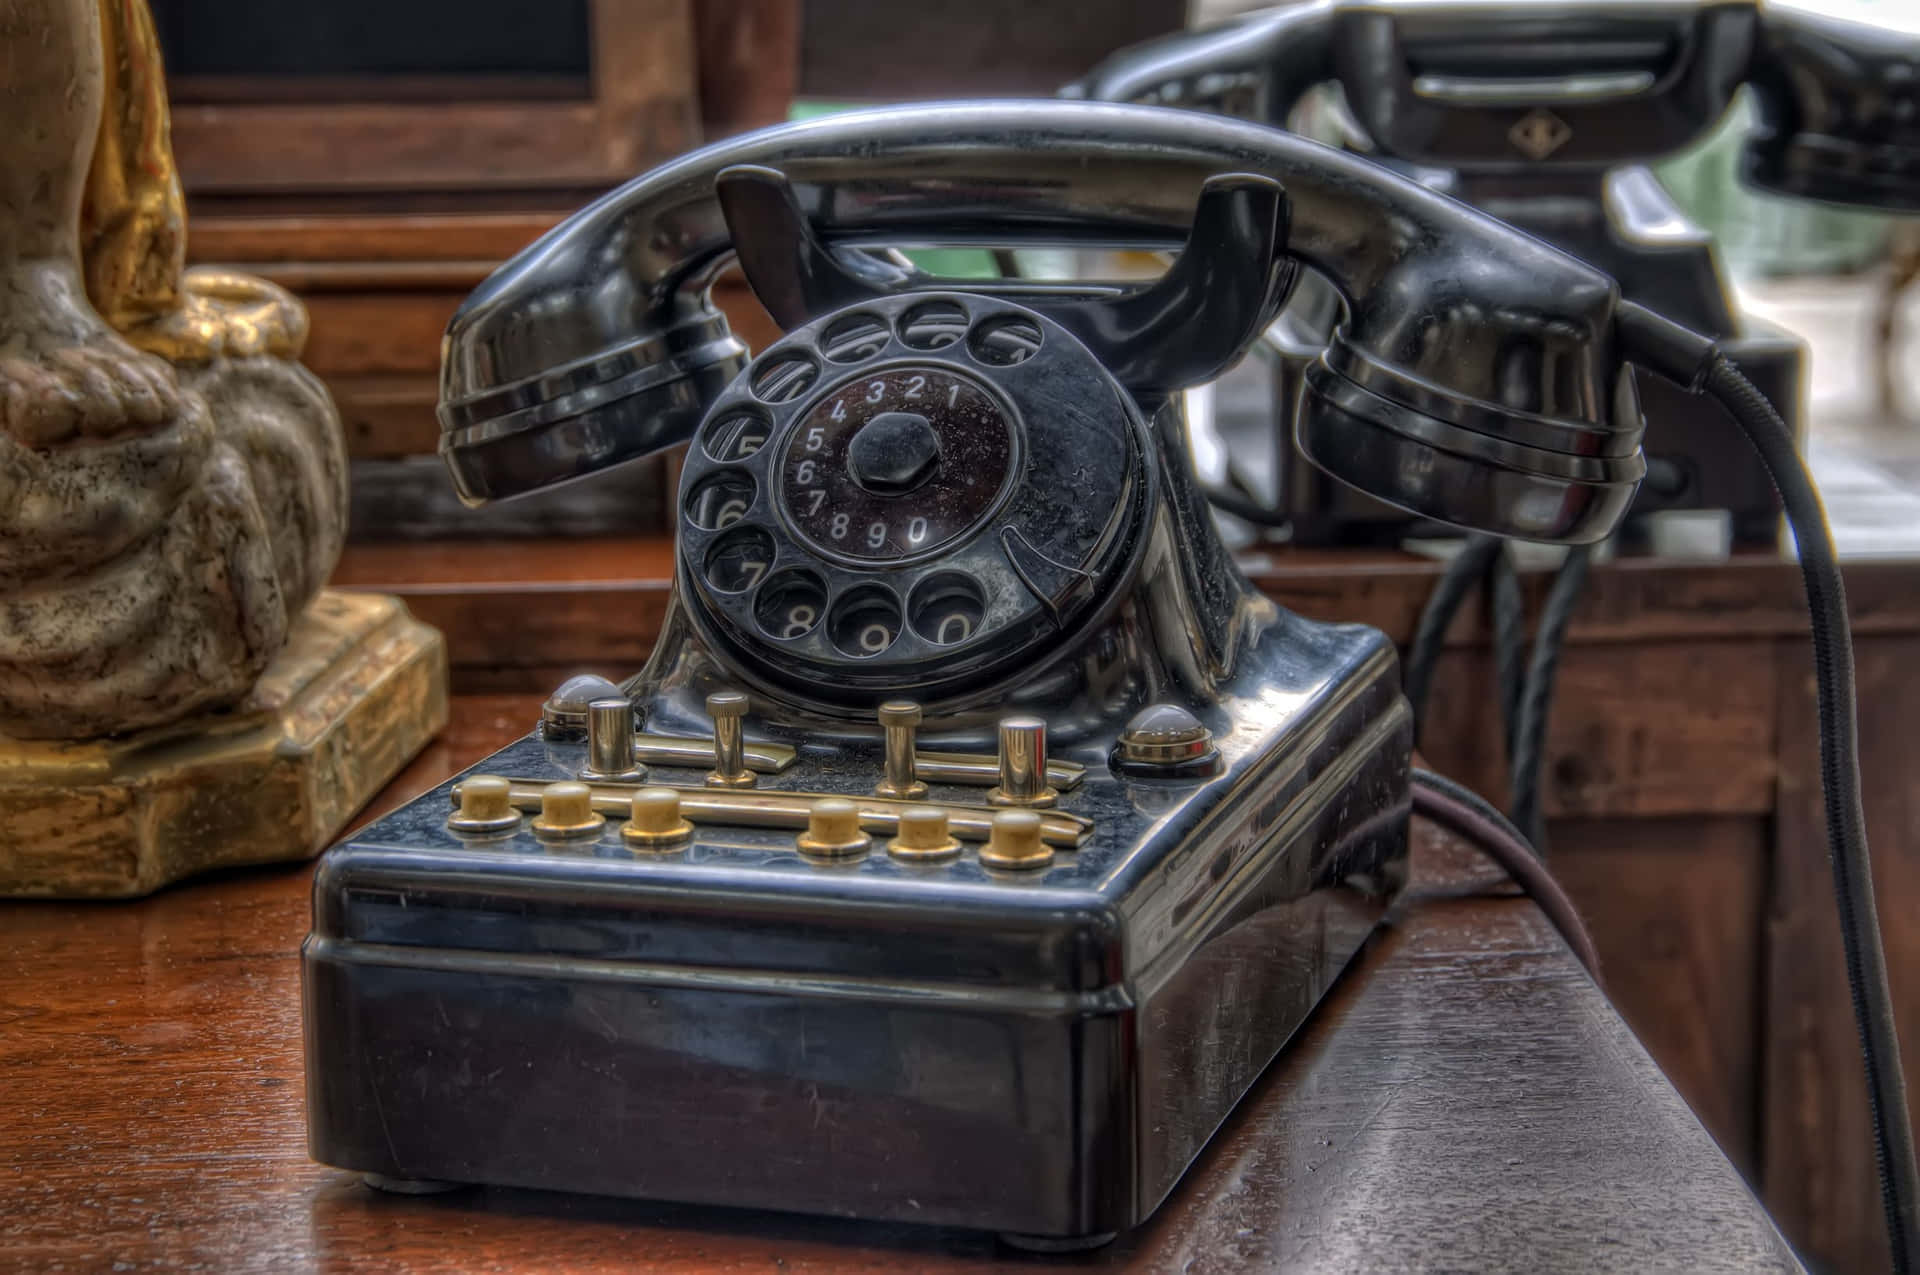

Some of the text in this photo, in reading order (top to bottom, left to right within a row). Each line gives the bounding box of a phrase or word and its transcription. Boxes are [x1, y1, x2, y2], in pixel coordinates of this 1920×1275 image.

[866, 381, 886, 403] 3
[904, 375, 926, 399] 2
[949, 384, 960, 408] 1
[831, 400, 847, 423] 4
[805, 428, 825, 451] 5
[796, 460, 816, 485] 6
[716, 499, 747, 529] 6
[809, 490, 826, 516] 7
[831, 513, 849, 540] 8
[867, 522, 887, 548] 9
[908, 516, 928, 543] 0
[741, 562, 767, 590] 7
[783, 605, 815, 638] 8
